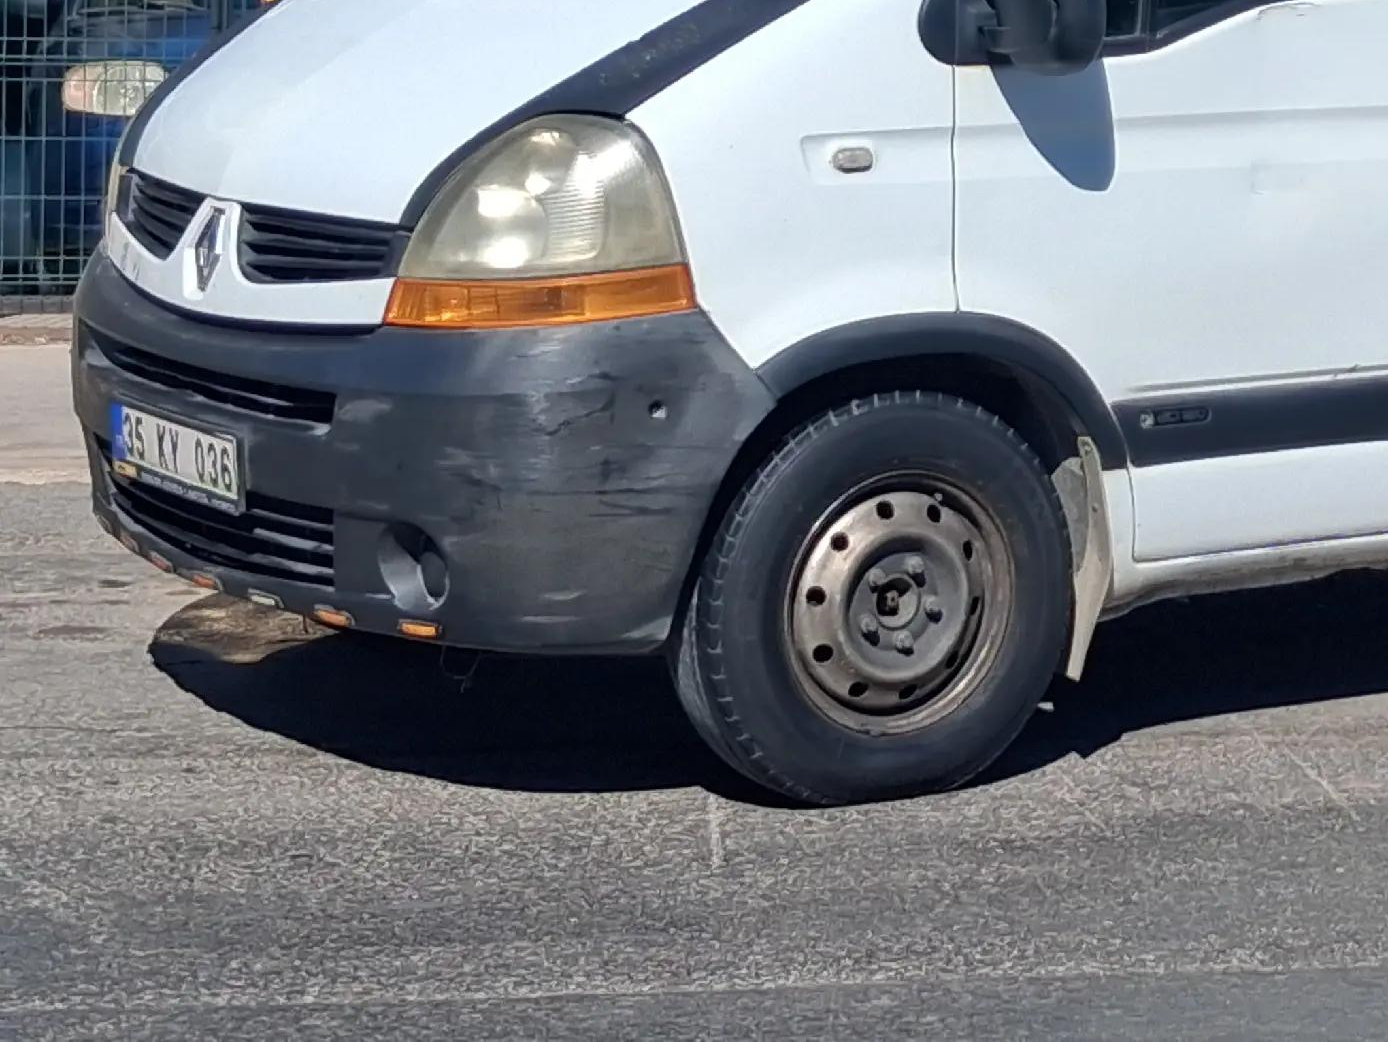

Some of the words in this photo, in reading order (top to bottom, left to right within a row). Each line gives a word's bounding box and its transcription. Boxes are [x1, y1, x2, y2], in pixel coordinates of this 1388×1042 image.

[123, 412, 145, 461] 35
[156, 422, 180, 475] KY
[194, 435, 232, 493] 036
